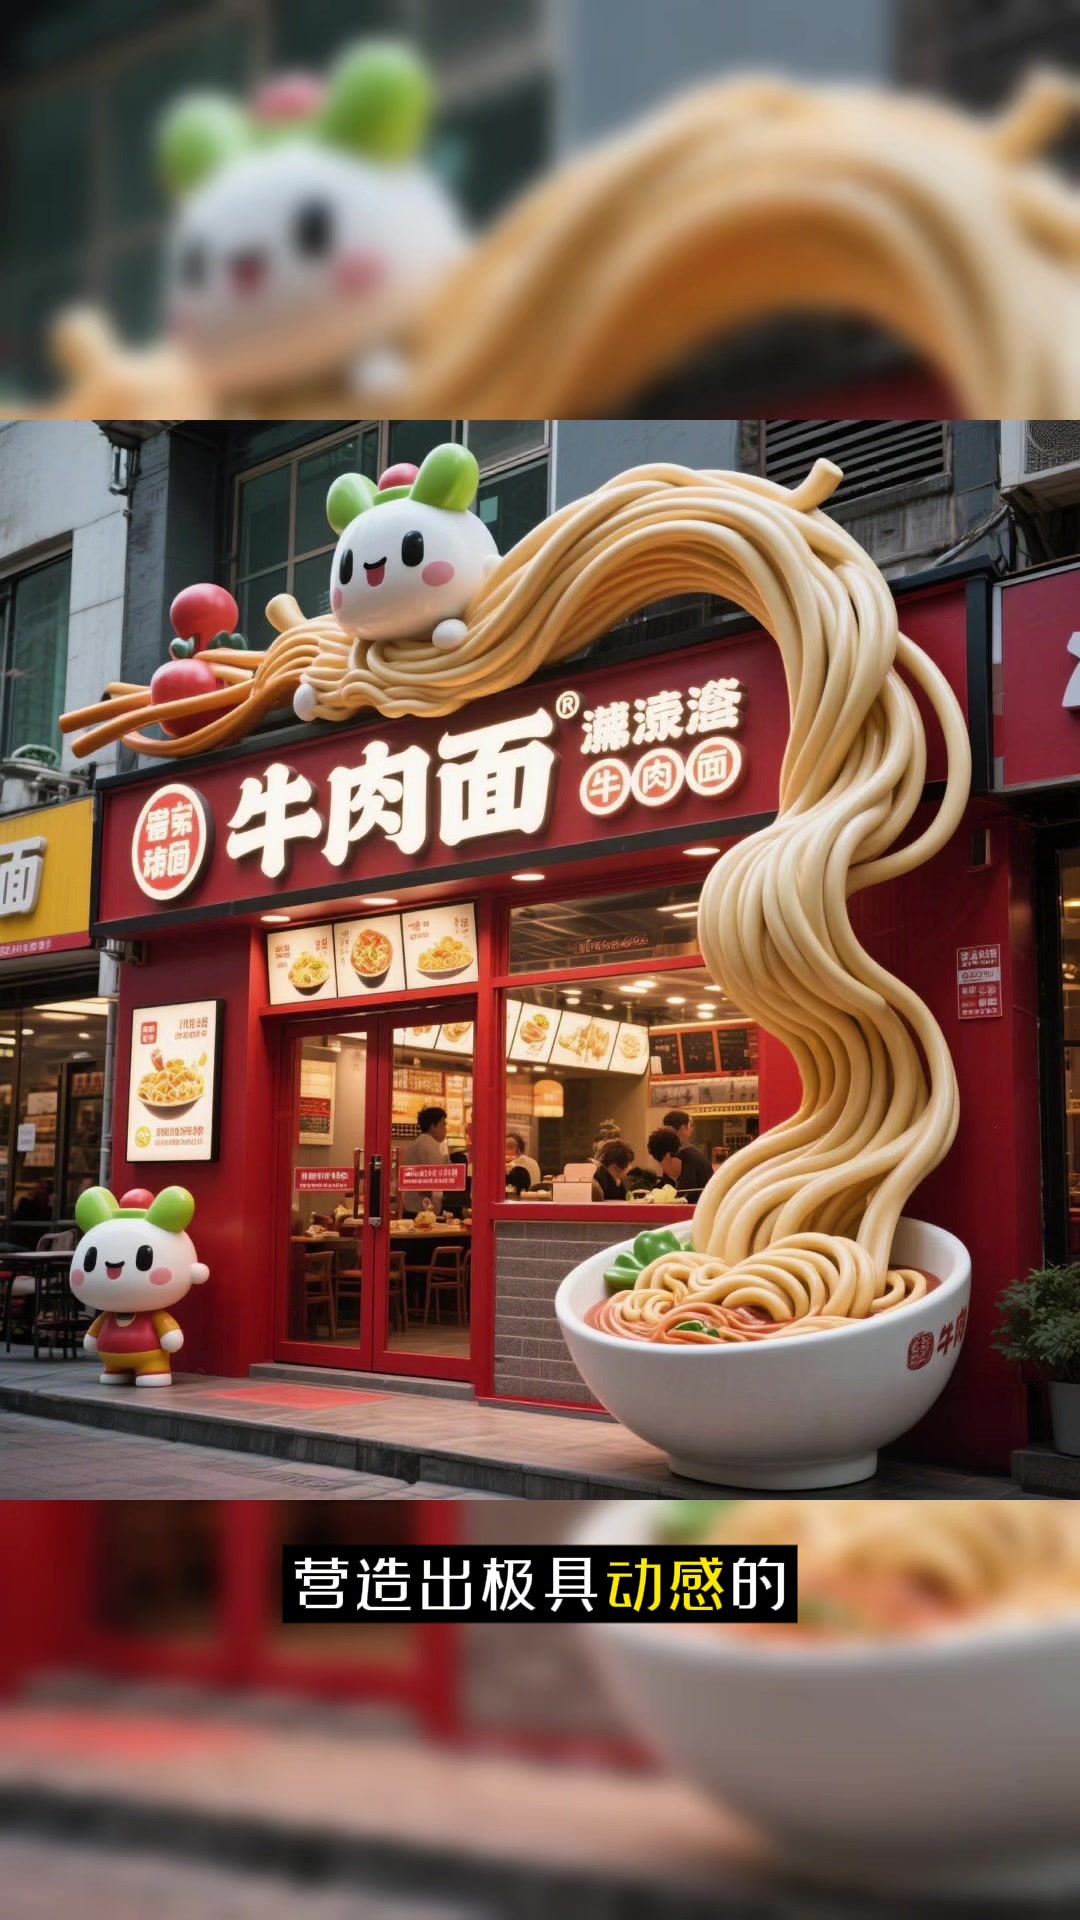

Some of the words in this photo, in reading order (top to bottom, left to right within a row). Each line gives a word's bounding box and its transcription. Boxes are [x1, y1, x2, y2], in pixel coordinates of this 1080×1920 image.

[226, 707, 555, 878] 牛肉面
[585, 746, 732, 806] 牛肉面
